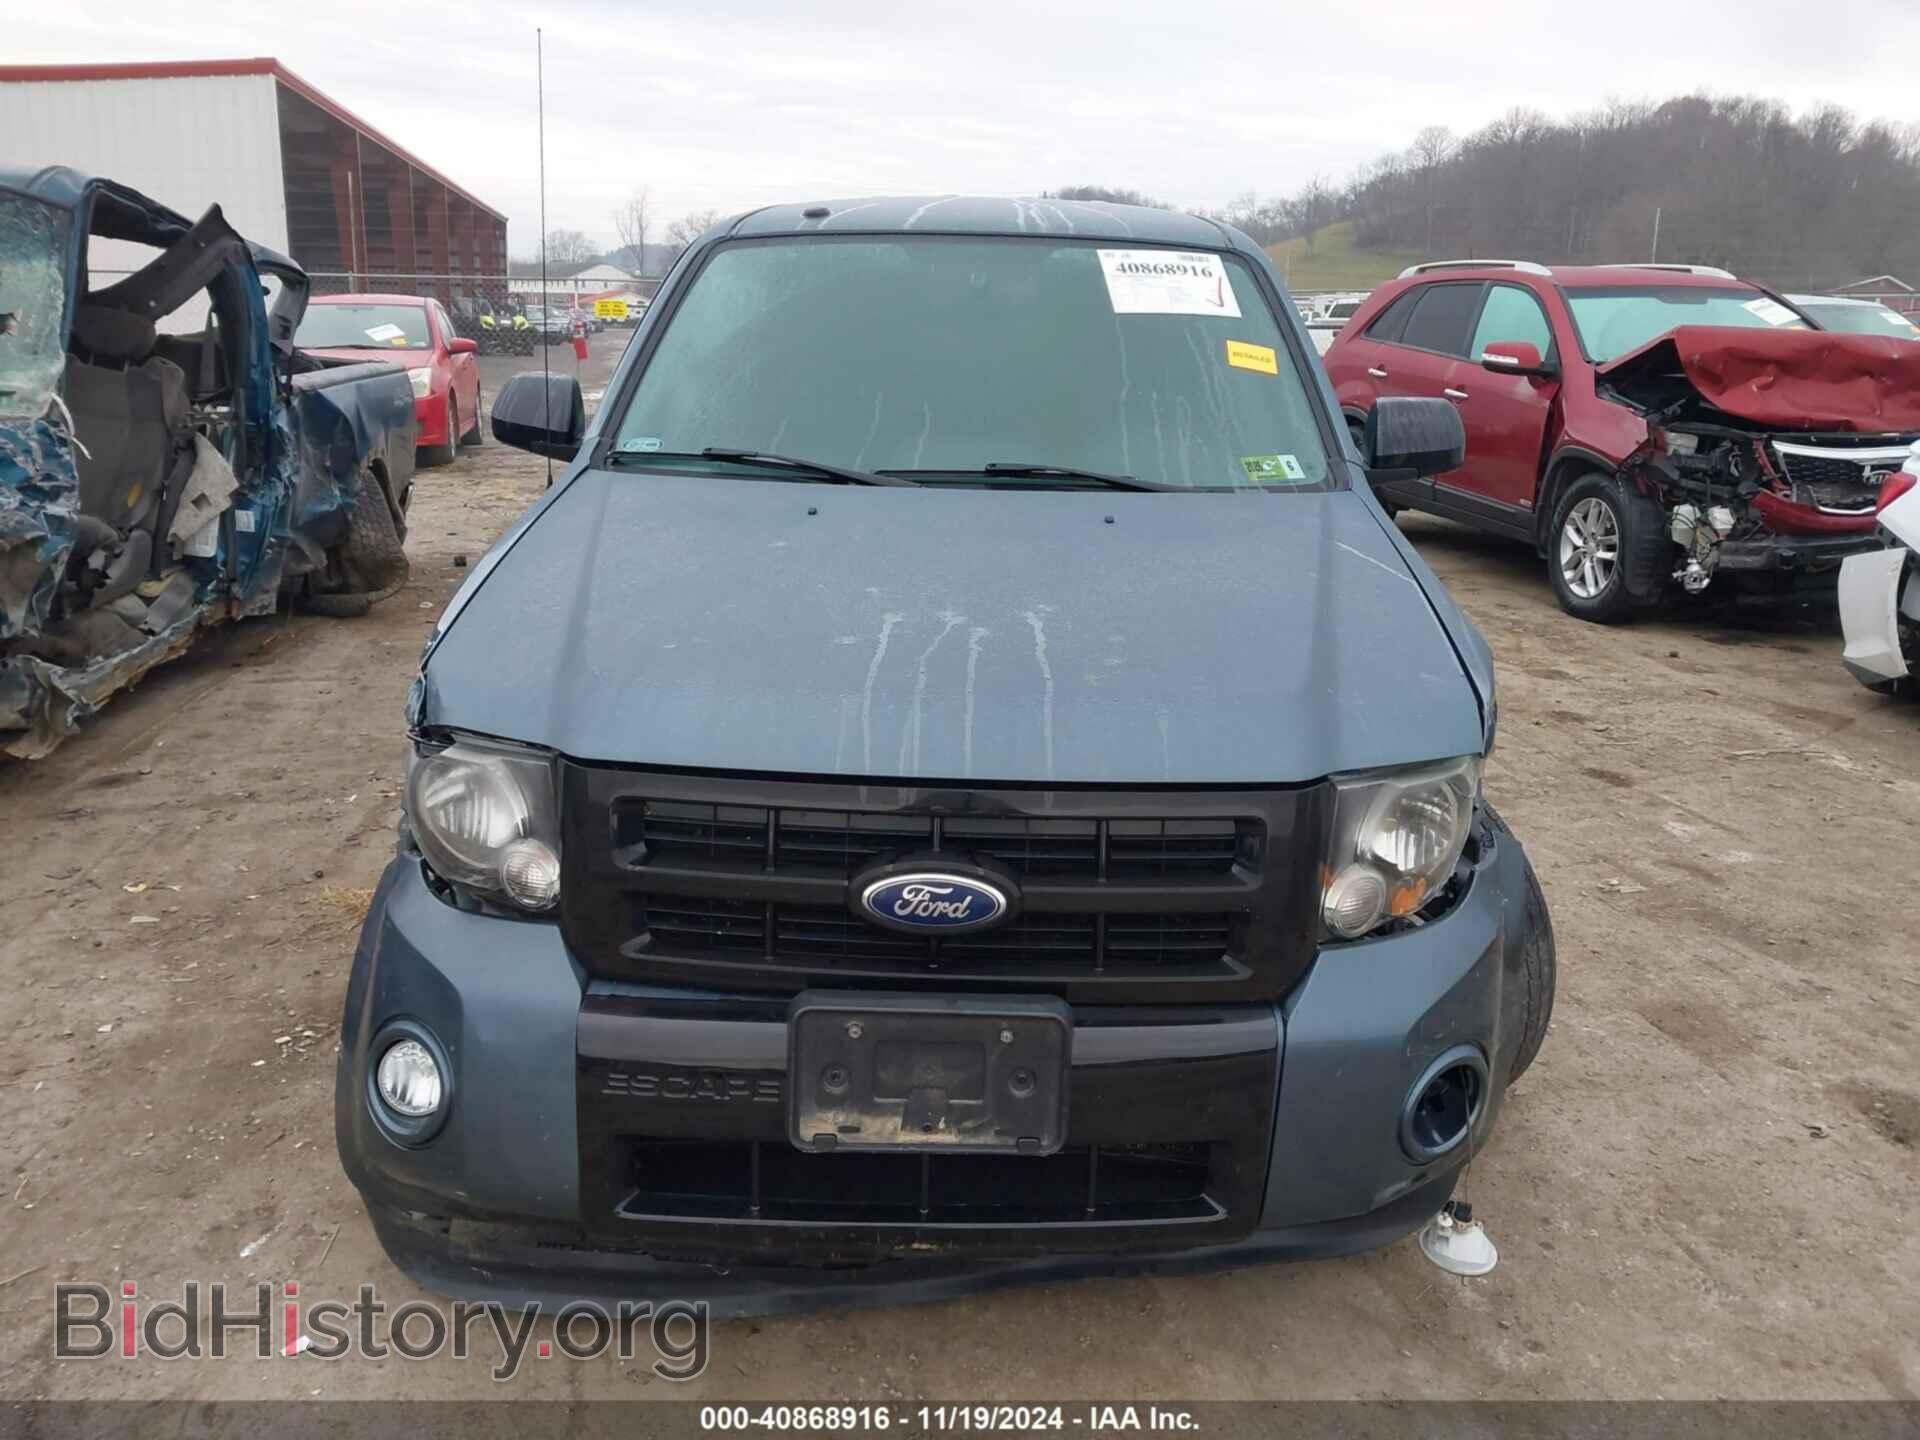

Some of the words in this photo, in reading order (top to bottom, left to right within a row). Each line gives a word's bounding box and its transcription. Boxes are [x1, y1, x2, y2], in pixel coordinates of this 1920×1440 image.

[1115, 261, 1213, 278] 40868916
[894, 884, 972, 919] Ford
[602, 1073, 781, 1103] ESCAPE
